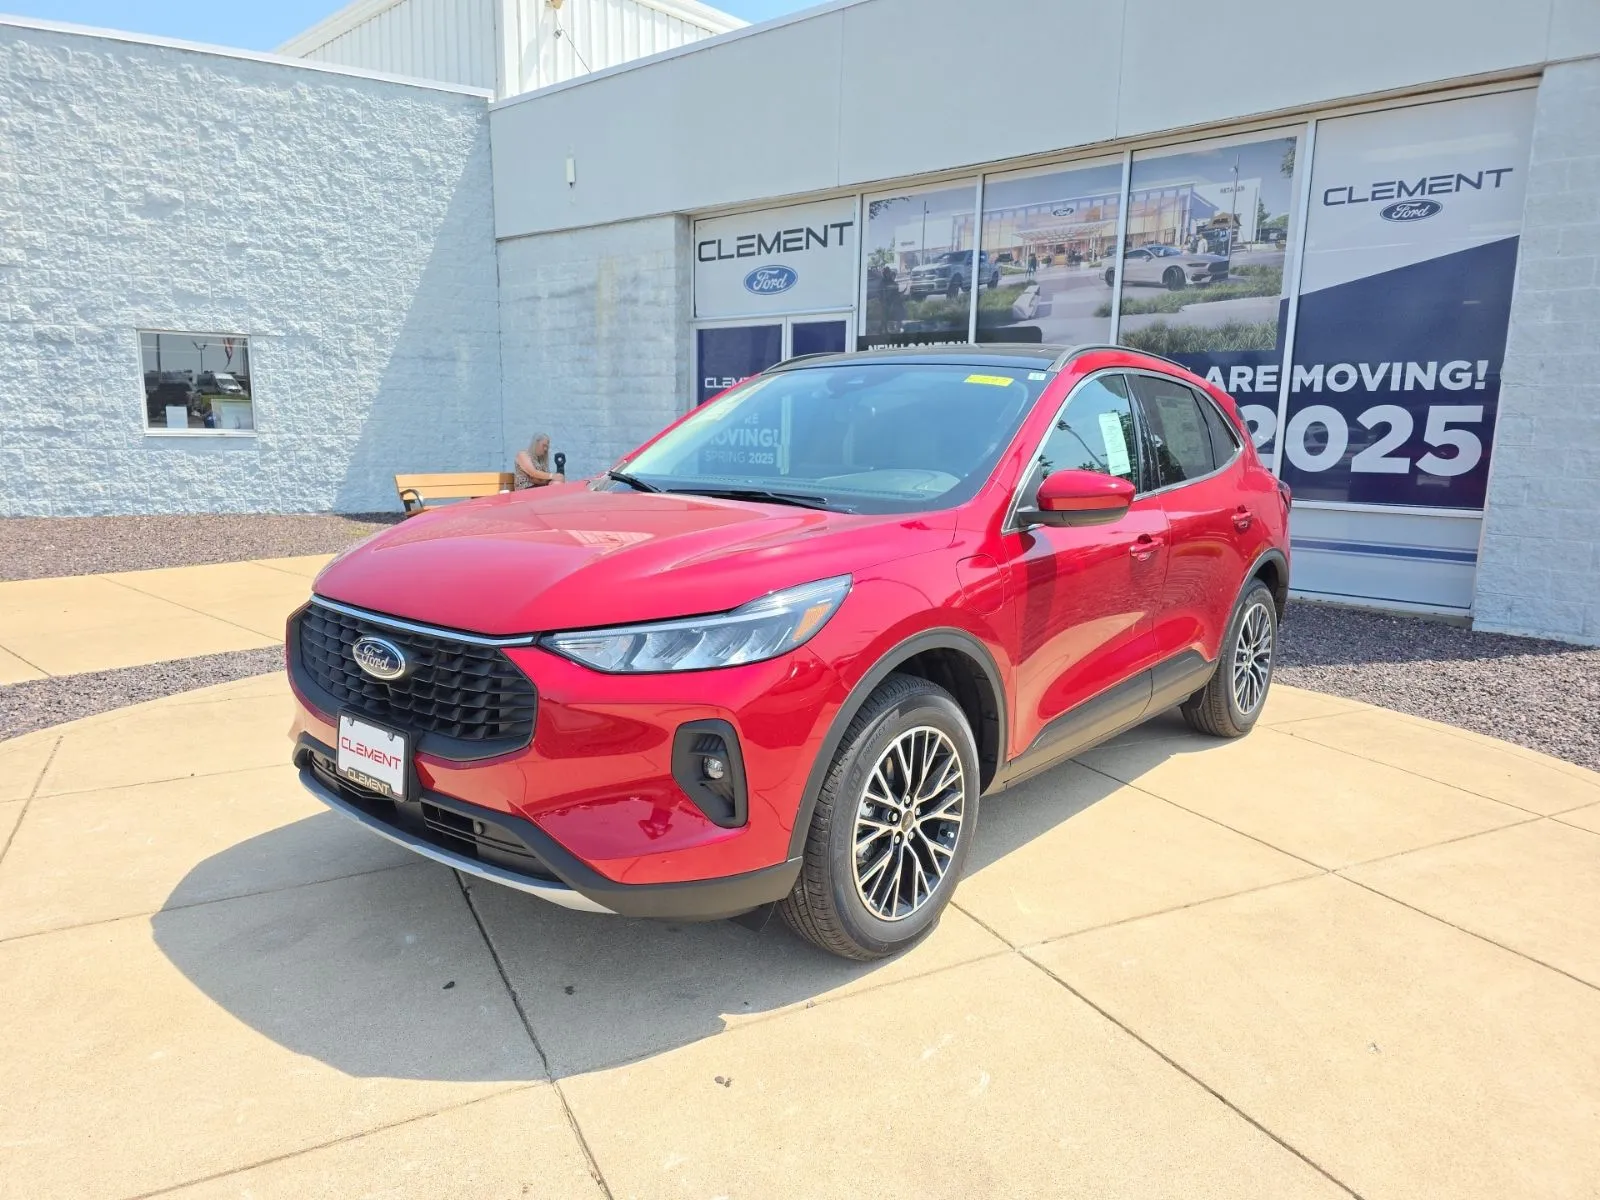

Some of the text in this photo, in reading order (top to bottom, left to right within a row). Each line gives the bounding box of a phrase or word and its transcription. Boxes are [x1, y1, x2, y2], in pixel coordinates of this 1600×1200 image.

[1323, 167, 1513, 206] CLEMENT
[1390, 202, 1433, 219] Ford
[697, 221, 853, 262] CLEMENT
[753, 269, 788, 290] Ford
[704, 376, 750, 388] CLEM
[1205, 360, 1489, 392] ARE MOVING!
[711, 428, 779, 447] OVING!
[1239, 404, 1484, 476] 2025
[748, 452, 774, 465] 2025
[359, 644, 389, 671] Ford
[341, 736, 401, 770] CLEMENT
[348, 769, 390, 795] CLEMENT
